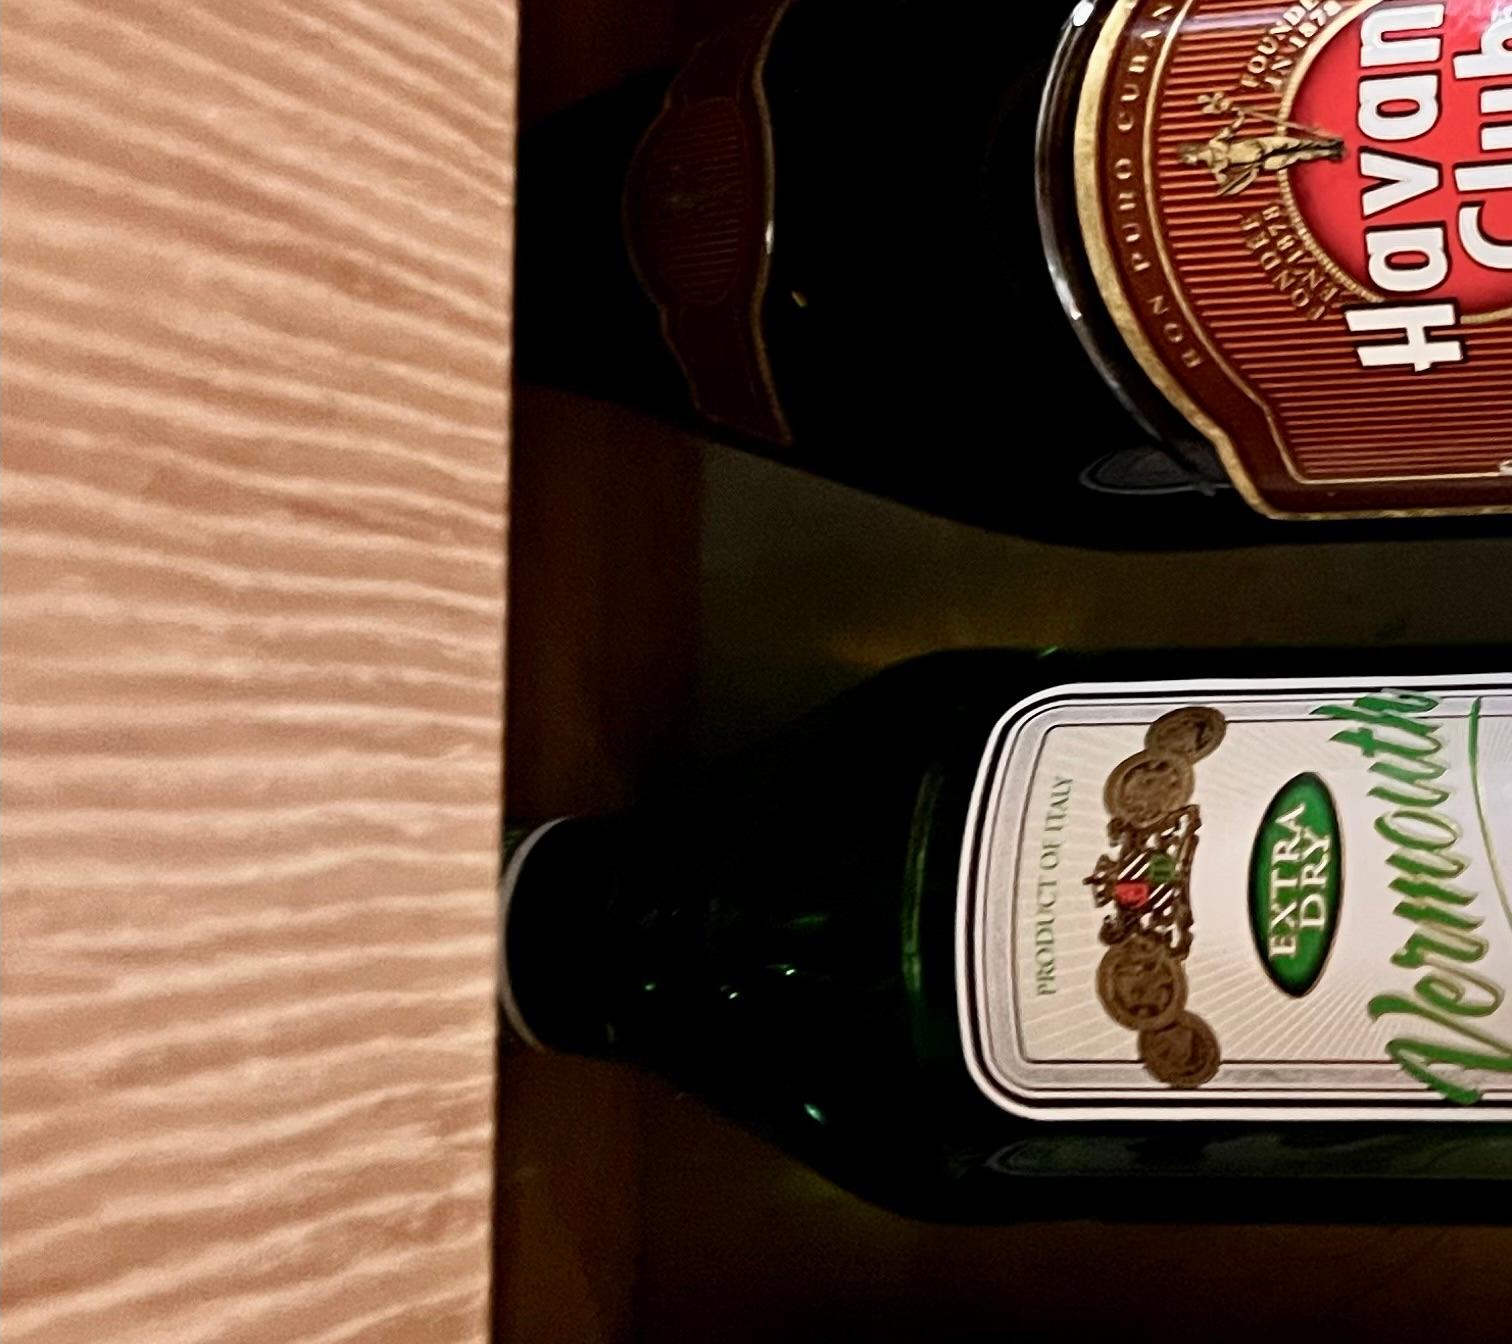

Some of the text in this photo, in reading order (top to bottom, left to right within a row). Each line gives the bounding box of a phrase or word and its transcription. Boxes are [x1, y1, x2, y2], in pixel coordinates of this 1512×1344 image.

[1113, 157, 1152, 272] PURO
[1034, 775, 1074, 998] PRODUCT OF ITALY
[1268, 802, 1308, 958] EXTRA
[1299, 824, 1332, 930] DRY
